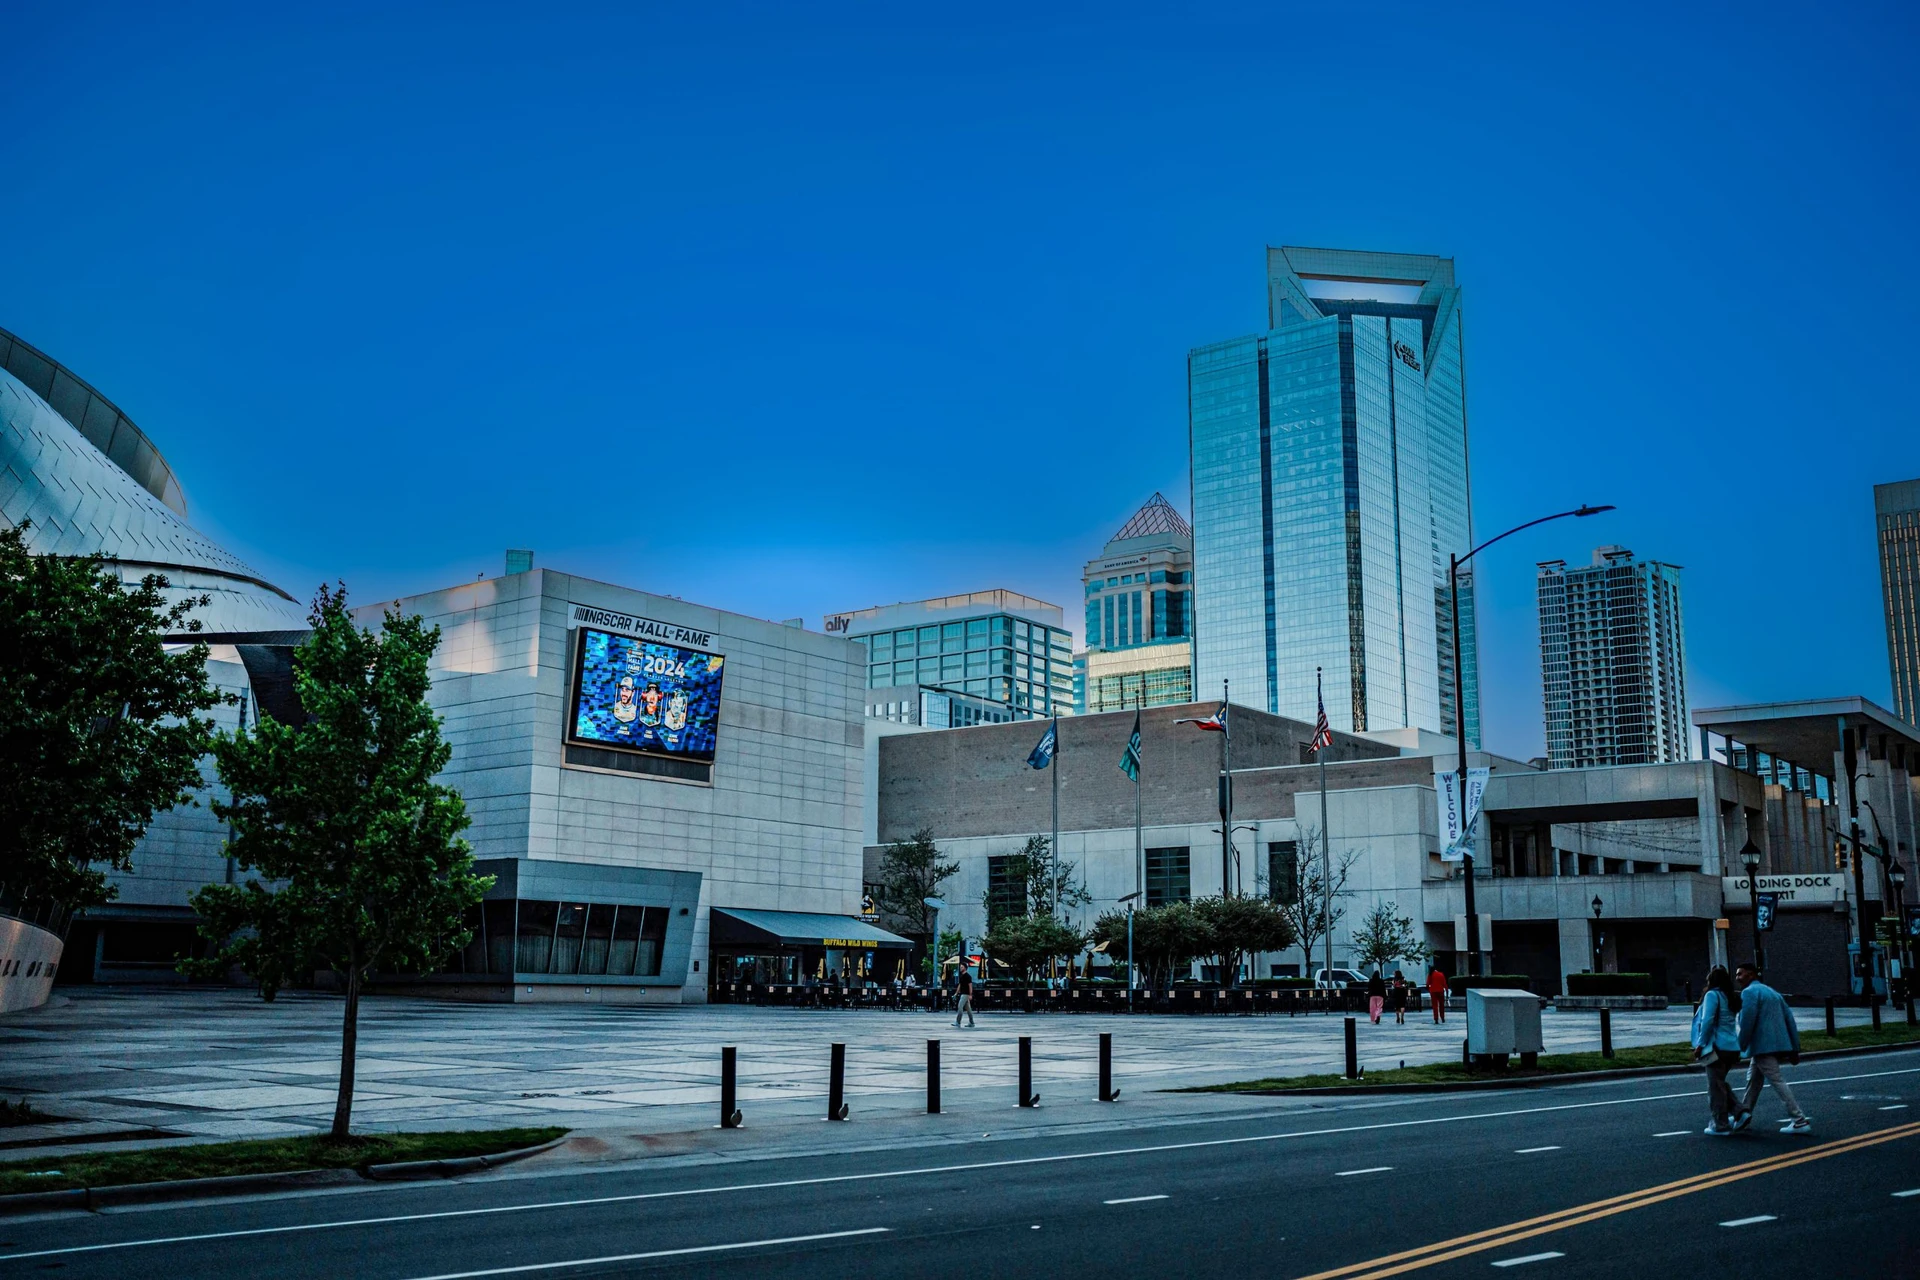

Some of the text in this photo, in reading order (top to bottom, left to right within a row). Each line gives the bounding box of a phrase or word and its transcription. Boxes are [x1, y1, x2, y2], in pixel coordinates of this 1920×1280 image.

[588, 609, 632, 630] NASCAR
[635, 620, 670, 638] HALL
[675, 629, 710, 647] FAME
[825, 615, 850, 634] ally
[644, 655, 685, 678] 2024
[1443, 774, 1457, 839] WELCOME
[1795, 877, 1831, 888] DOCK
[1777, 891, 1795, 900] XIT
[823, 938, 878, 948] BUFFALO WILD WINGS
